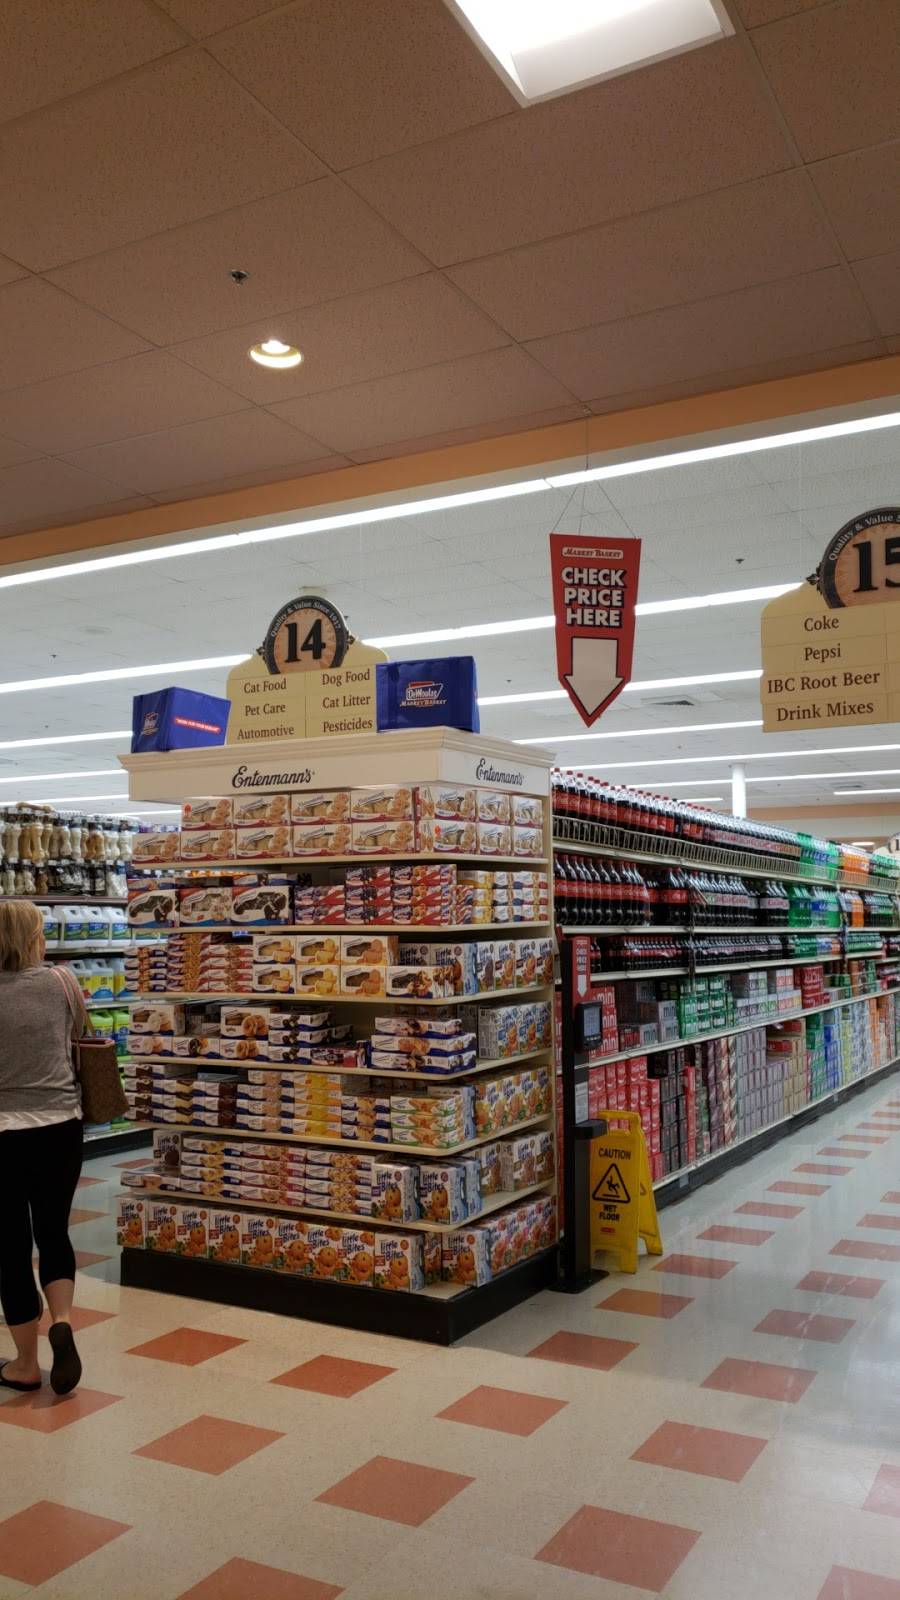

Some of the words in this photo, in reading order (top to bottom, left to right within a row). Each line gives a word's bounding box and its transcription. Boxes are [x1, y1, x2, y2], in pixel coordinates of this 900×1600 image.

[827, 530, 854, 561] Quality
[865, 514, 893, 526] Value
[561, 566, 625, 587] CHECK
[564, 587, 623, 608] PRICE
[566, 608, 621, 628] HERE
[804, 616, 840, 632] Coke
[284, 618, 327, 663] 14
[804, 643, 842, 663] Pepsi
[244, 683, 260, 694] Cat
[263, 678, 287, 692] Food
[322, 674, 343, 687] Dog
[346, 668, 371, 683] Food
[767, 678, 796, 694] IBC
[800, 675, 838, 691] Root
[843, 672, 880, 687] Beer
[245, 705, 260, 717] Pet
[263, 703, 287, 715] Care
[322, 697, 340, 709] Cat
[343, 694, 372, 708] Litter
[777, 704, 821, 722] Drink
[827, 701, 875, 718] Mixes
[237, 724, 295, 741] Automotive
[323, 717, 374, 733] Pesticides
[232, 765, 312, 788] Entenmann's
[476, 758, 523, 786] Entenmann's
[599, 1148, 631, 1160] CAUTION
[599, 1212, 620, 1222] FLOOR
